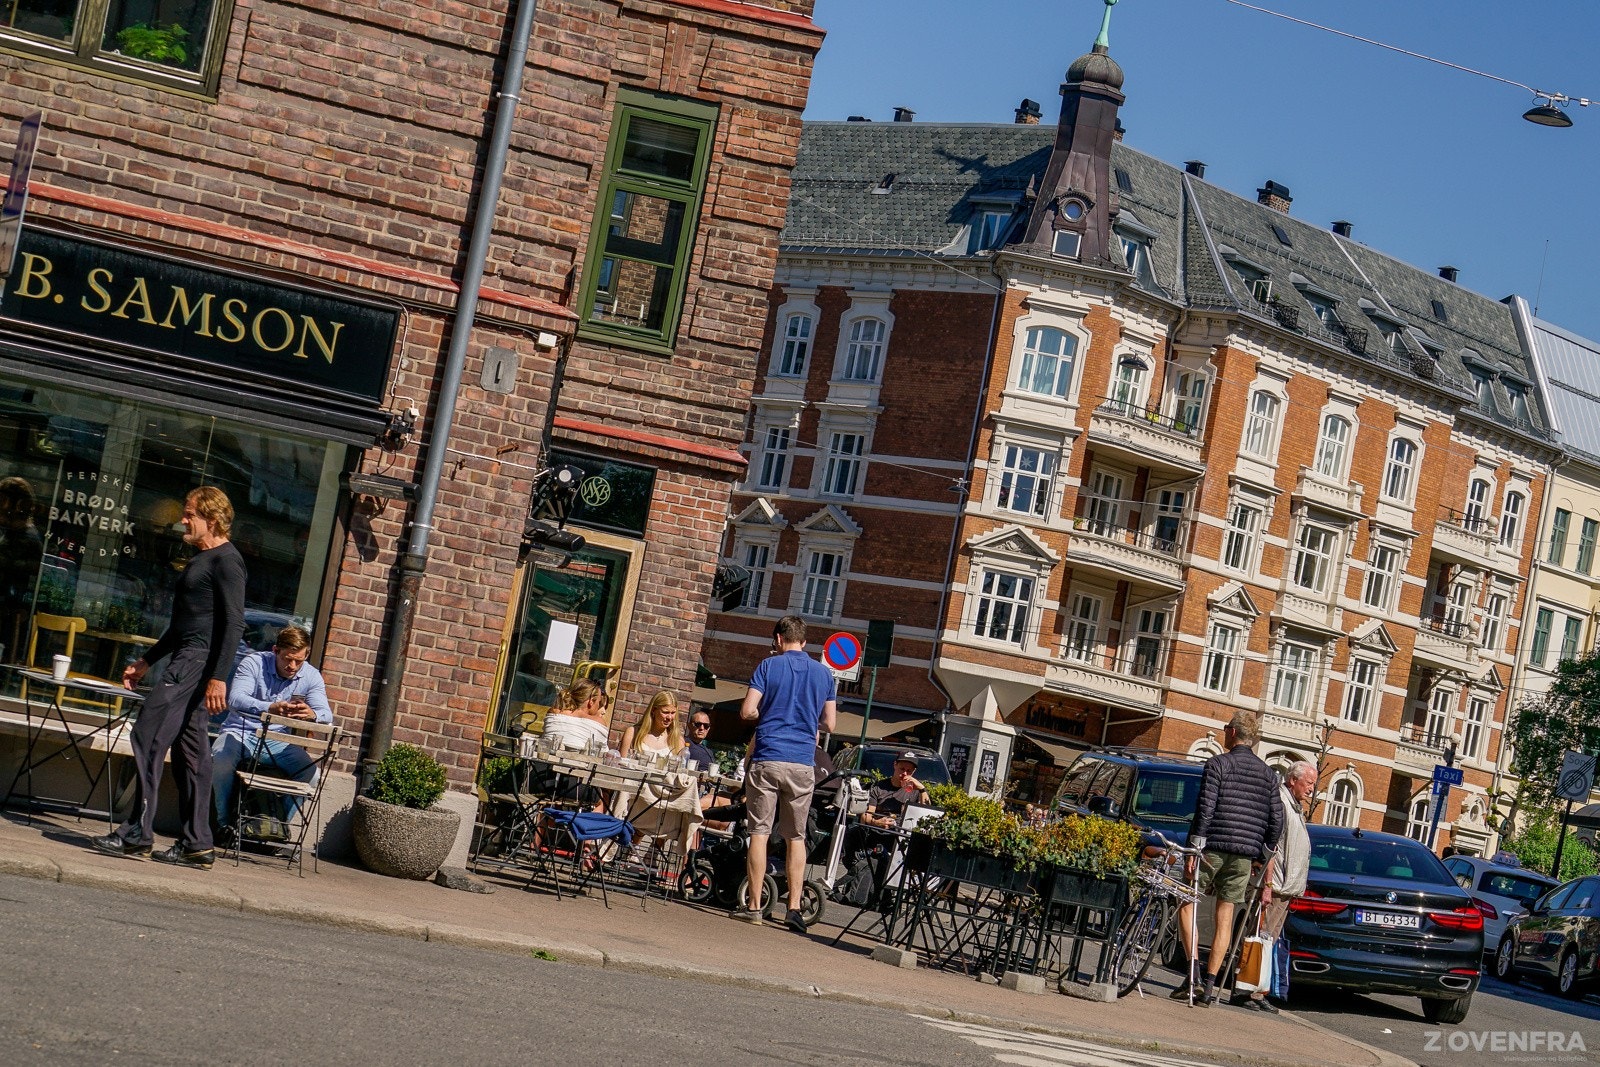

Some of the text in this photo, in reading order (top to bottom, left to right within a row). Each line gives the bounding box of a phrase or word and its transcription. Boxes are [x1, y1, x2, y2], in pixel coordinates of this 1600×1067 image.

[13, 251, 345, 365] B. SAMSON
[66, 471, 132, 492] FERSKE
[63, 488, 130, 515] BRØD &
[48, 506, 136, 537] BAKVERK
[44, 529, 131, 557] HVER DAG
[1567, 754, 1593, 769] Son
[1438, 768, 1459, 781] Taxi
[1365, 911, 1417, 927] BT 64334
